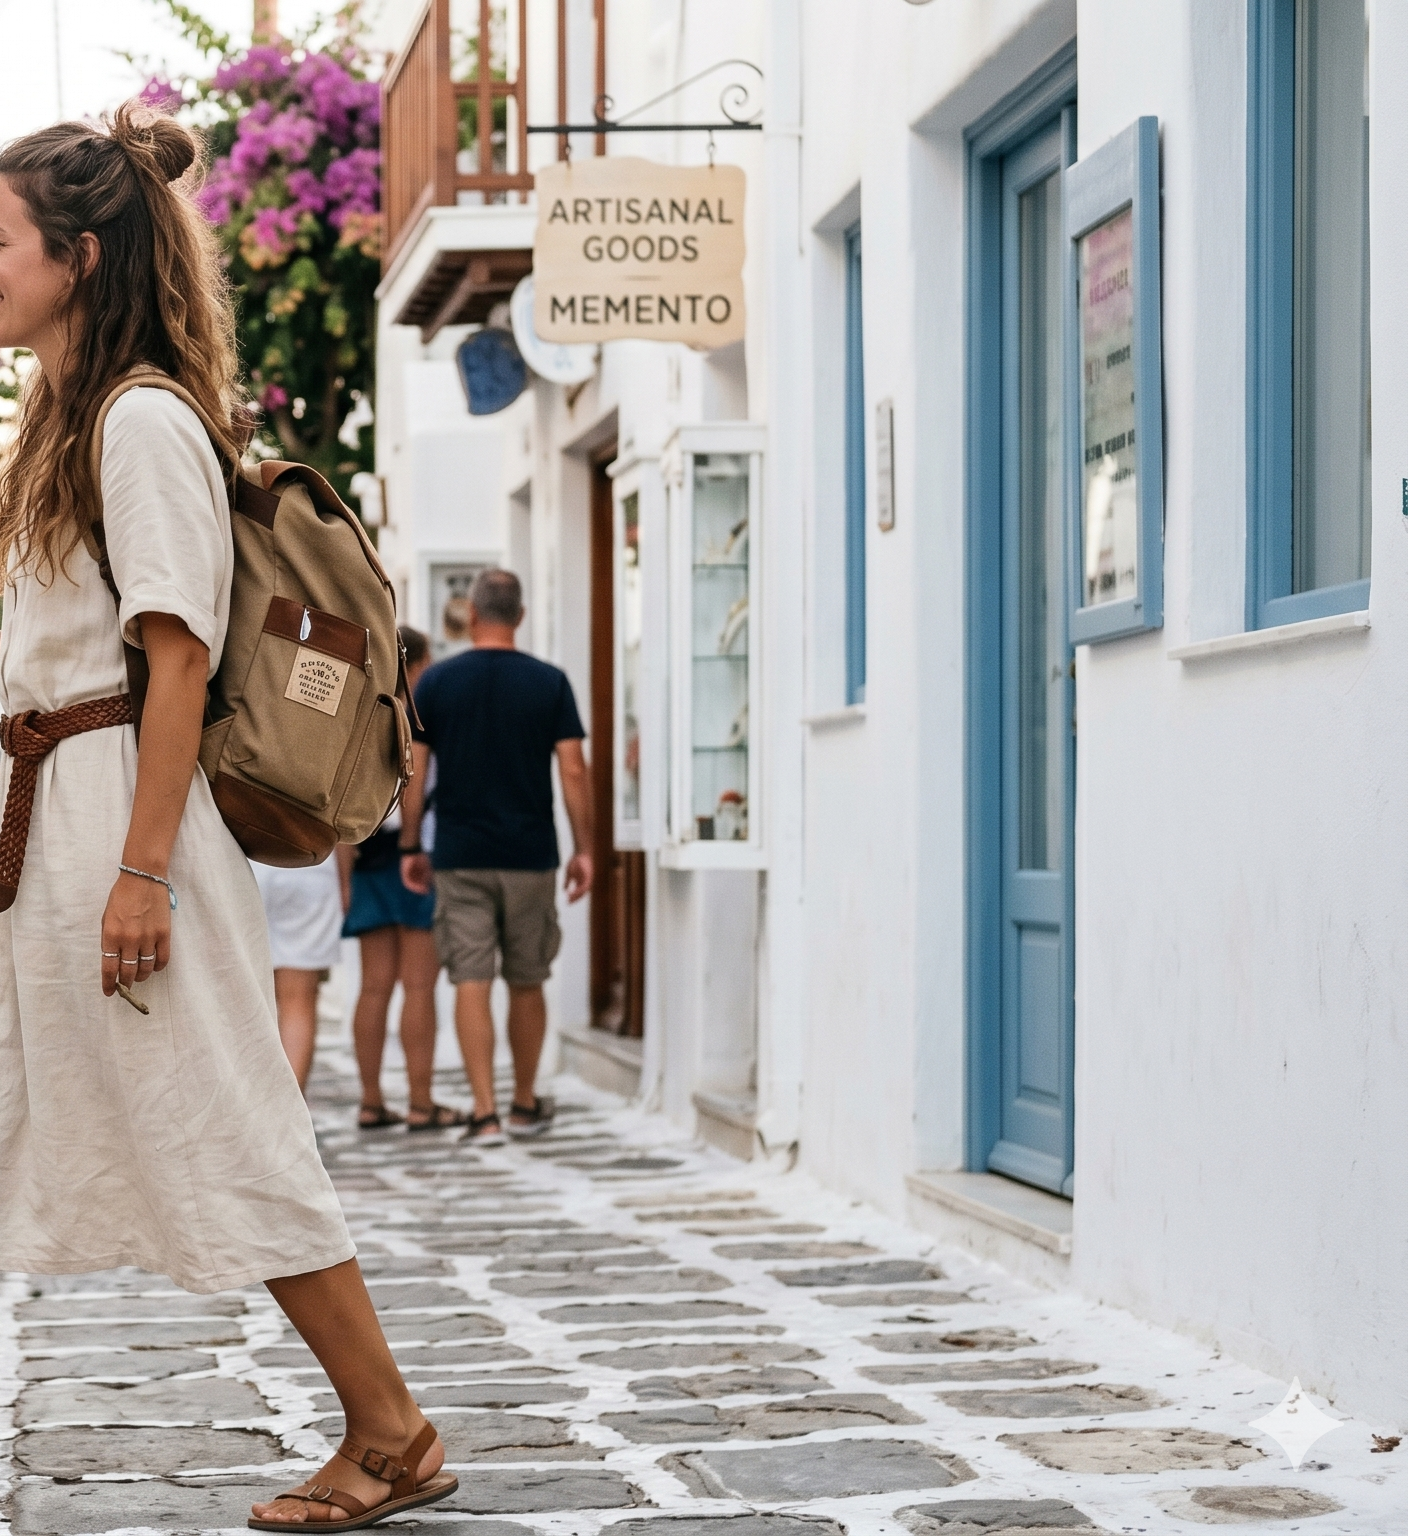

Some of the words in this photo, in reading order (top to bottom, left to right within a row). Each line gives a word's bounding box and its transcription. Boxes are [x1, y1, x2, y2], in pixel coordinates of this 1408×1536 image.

[547, 198, 734, 226] ARTISANAL
[582, 235, 699, 263] GOODS
[549, 294, 732, 325] MEMENTO
